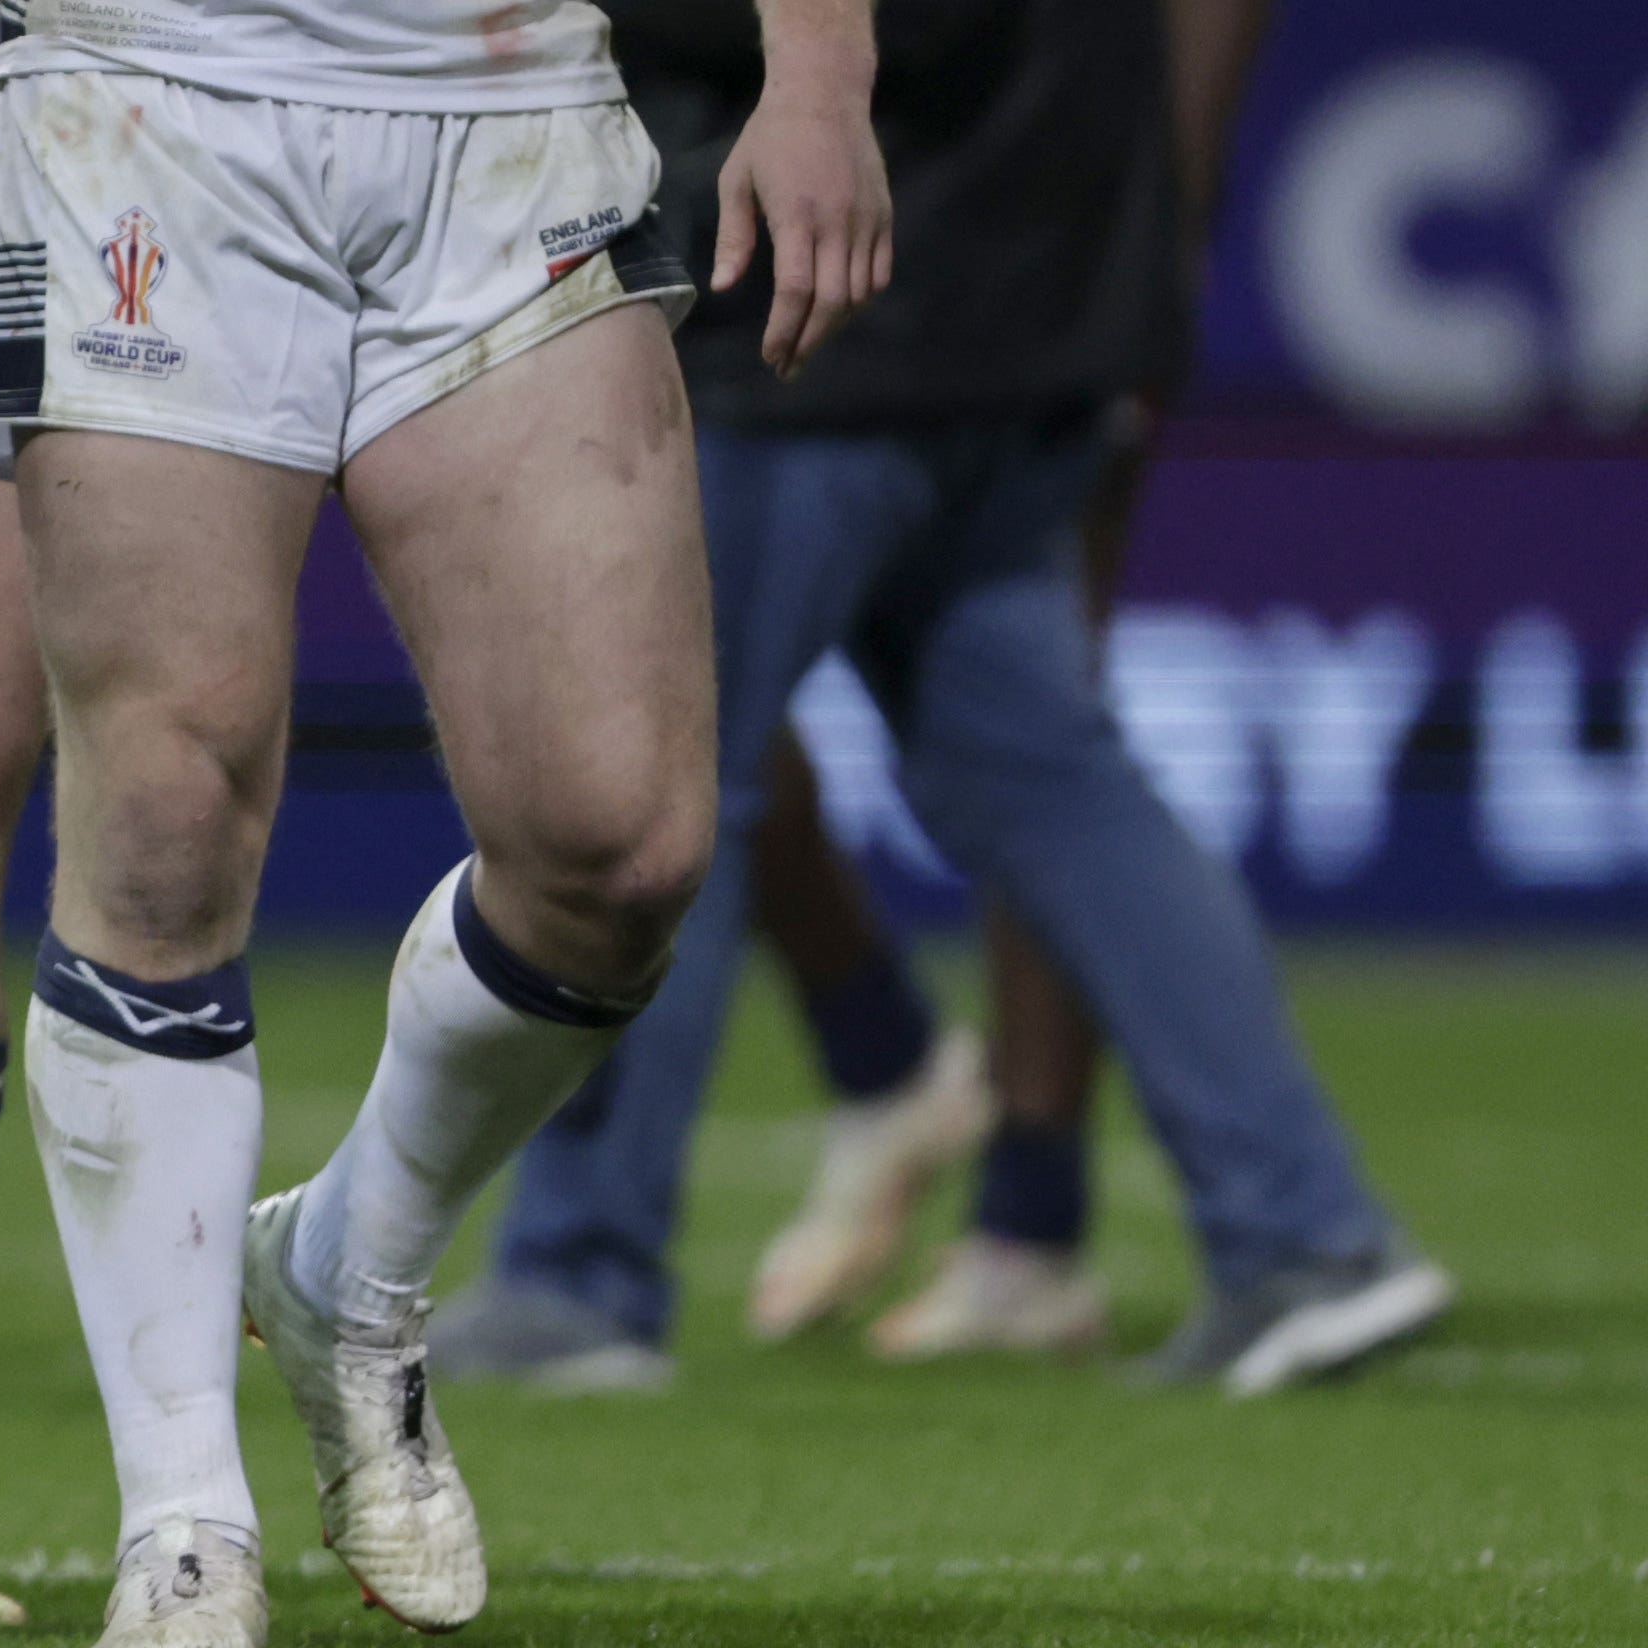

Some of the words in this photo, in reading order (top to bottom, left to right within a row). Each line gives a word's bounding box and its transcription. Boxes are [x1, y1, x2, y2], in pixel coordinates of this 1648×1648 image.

[539, 205, 623, 246] ENGLAND
[545, 238, 583, 258] RUGBY
[77, 337, 139, 360] WORLD
[145, 347, 181, 365] CUP
